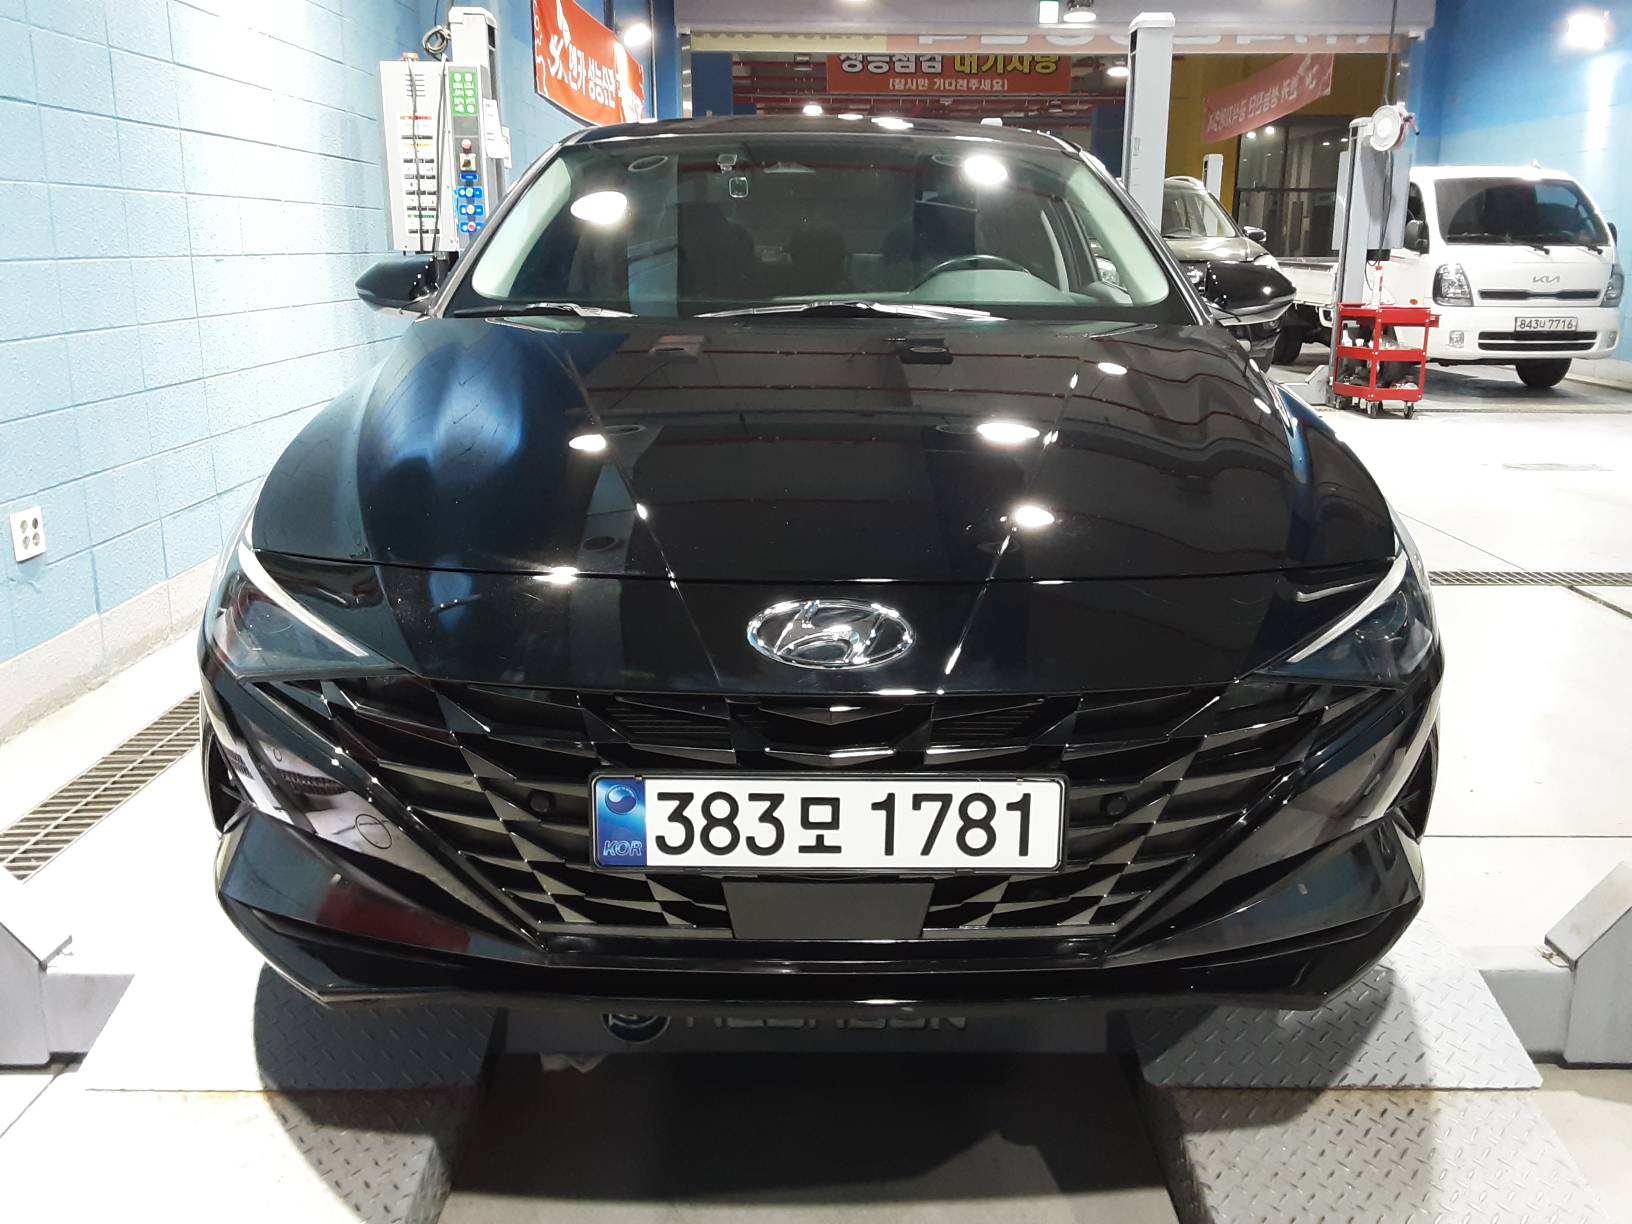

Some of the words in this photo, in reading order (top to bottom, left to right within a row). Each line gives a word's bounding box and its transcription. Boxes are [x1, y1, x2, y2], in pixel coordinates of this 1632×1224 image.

[1548, 319, 1574, 330] 7716
[655, 791, 842, 857] 383모
[870, 791, 1032, 857] 1781
[603, 840, 642, 857] KOR
